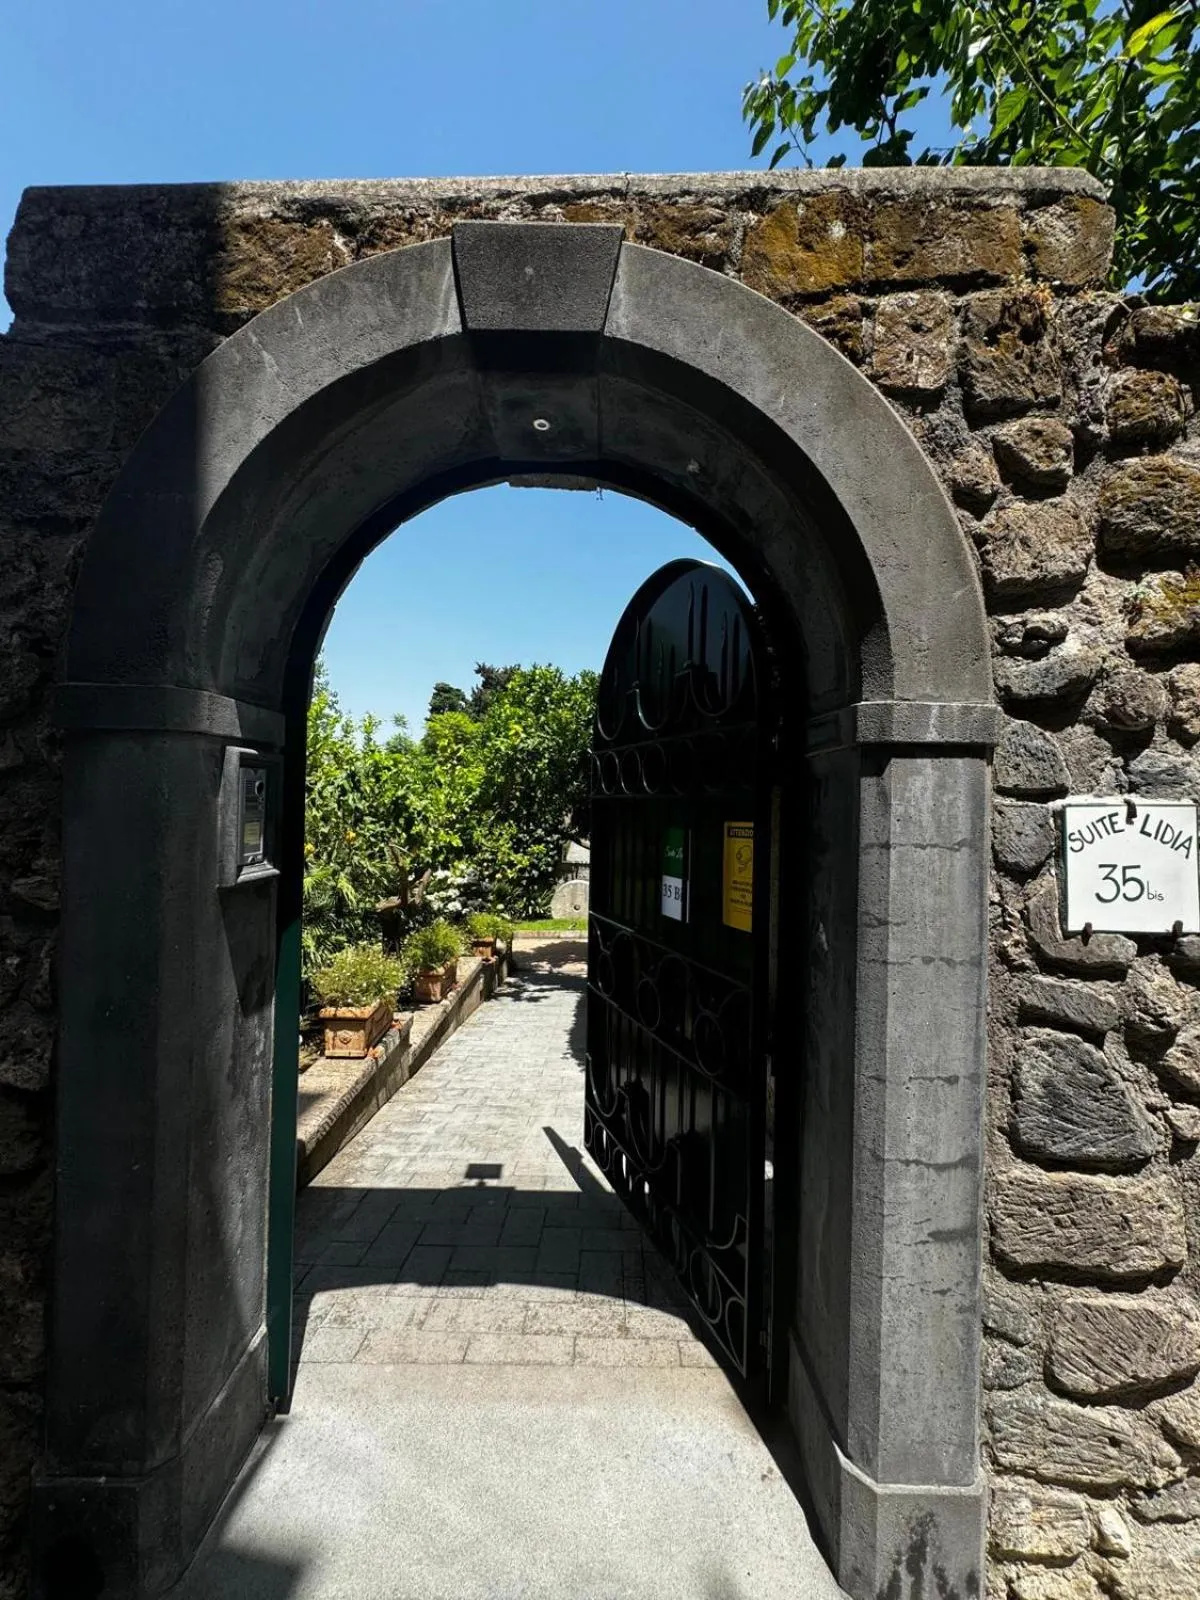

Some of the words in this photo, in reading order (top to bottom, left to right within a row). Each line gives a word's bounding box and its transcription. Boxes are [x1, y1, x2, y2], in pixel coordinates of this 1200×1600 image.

[1068, 812, 1125, 853] SUITE
[1139, 813, 1193, 859] LIDIA
[1095, 864, 1145, 903] 35
[1146, 880, 1164, 901] bis
